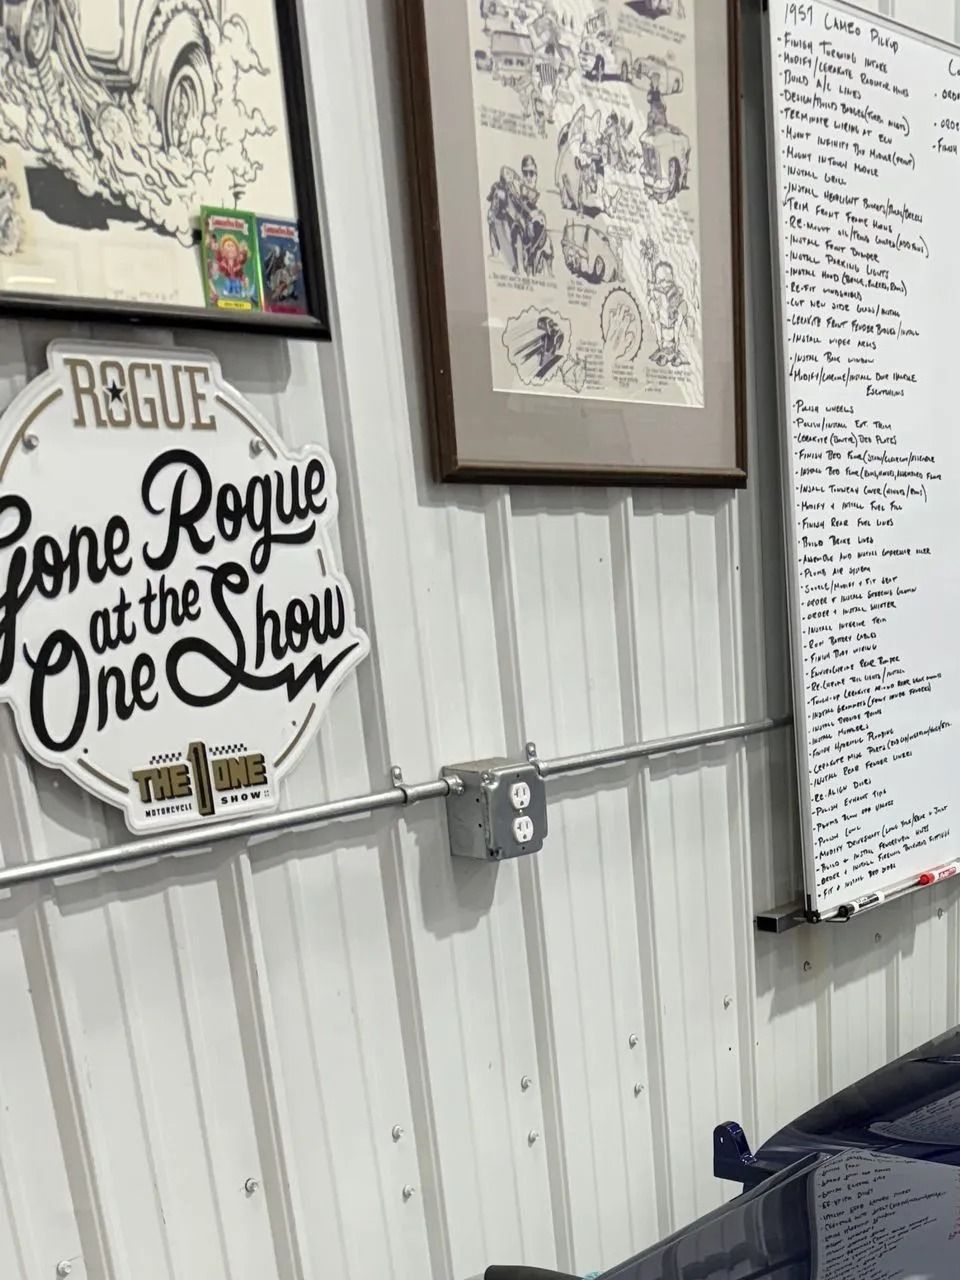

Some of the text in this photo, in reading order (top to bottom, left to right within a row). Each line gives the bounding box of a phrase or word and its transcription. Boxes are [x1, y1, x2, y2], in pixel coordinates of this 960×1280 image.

[825, 12, 861, 36] CAMEO
[870, 28, 899, 55] PICKUP
[784, 31, 813, 55] FINISH
[784, 69, 808, 86] BUILD
[786, 125, 811, 140] MOUNT
[787, 145, 812, 160] MOUNT
[788, 166, 818, 180] INSTALL
[788, 182, 819, 198] INSTALL
[787, 197, 809, 212] TRIM
[816, 205, 839, 220] FRONT
[790, 234, 820, 247] INSTALL
[790, 250, 821, 264] INSTALL
[790, 267, 816, 277] INSTALL
[790, 298, 805, 307] CUT
[810, 299, 826, 308] NEW
[792, 333, 821, 344] INSTALL
[63, 358, 217, 430] ROGUE
[800, 448, 823, 459] FINISH
[141, 449, 327, 575] Rogue
[801, 501, 825, 511] MODIFY
[802, 517, 824, 529] FINISH
[802, 536, 824, 548] BUILD
[90, 574, 199, 652] at the
[23, 561, 359, 752] One Show
[133, 764, 192, 803] THE
[211, 753, 267, 791] ONE
[145, 791, 261, 817] MOTORCYCLE SHOW
